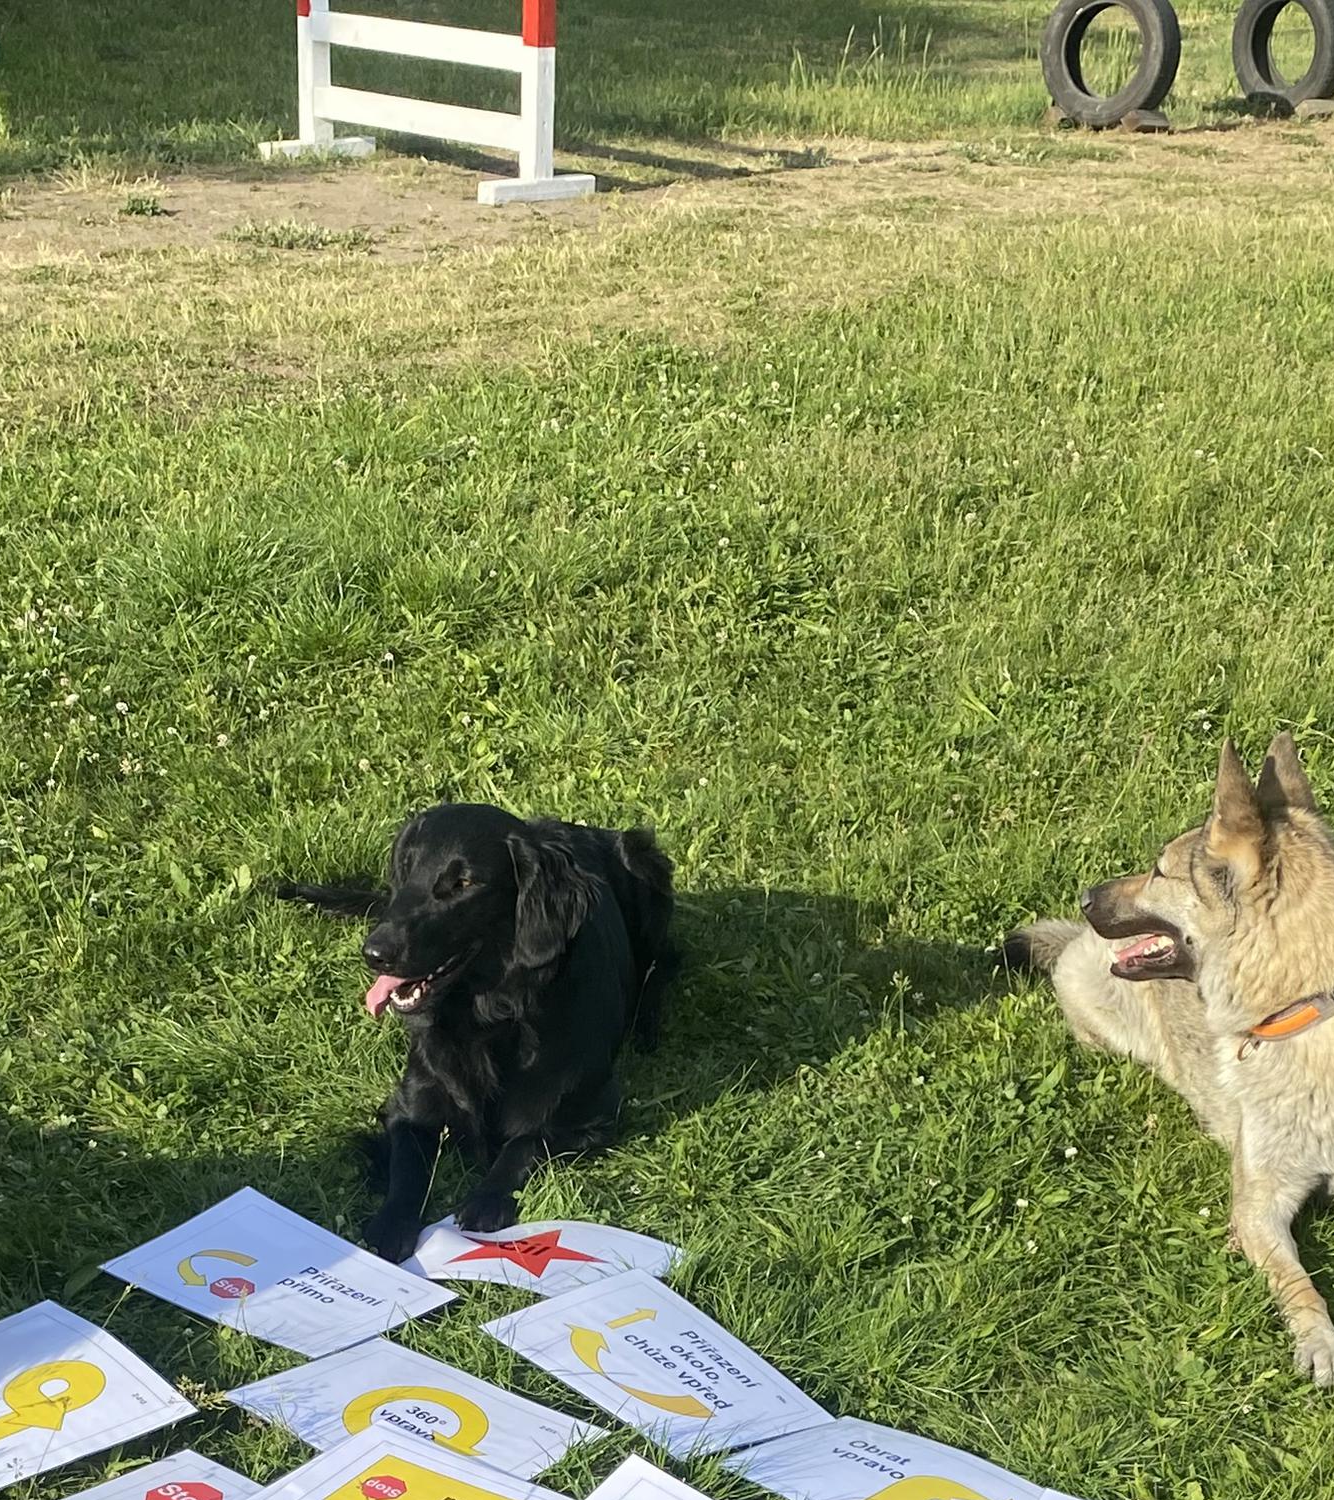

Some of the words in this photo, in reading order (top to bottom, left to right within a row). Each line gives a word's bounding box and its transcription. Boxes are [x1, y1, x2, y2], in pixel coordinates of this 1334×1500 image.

[215, 1280, 249, 1298] Stop
[276, 1278, 335, 1304] přímo
[298, 1266, 388, 1307] Přiřazení
[624, 1334, 677, 1370] chůze
[678, 1371, 734, 1410] vpřed
[670, 1344, 723, 1384] okolo,
[679, 1330, 762, 1389] Přiřazení
[380, 1409, 436, 1441] vpravo
[405, 1405, 448, 1425] 360°
[832, 1447, 906, 1480] vpravo
[848, 1440, 912, 1466] Obrat
[365, 1478, 402, 1498] Stop
